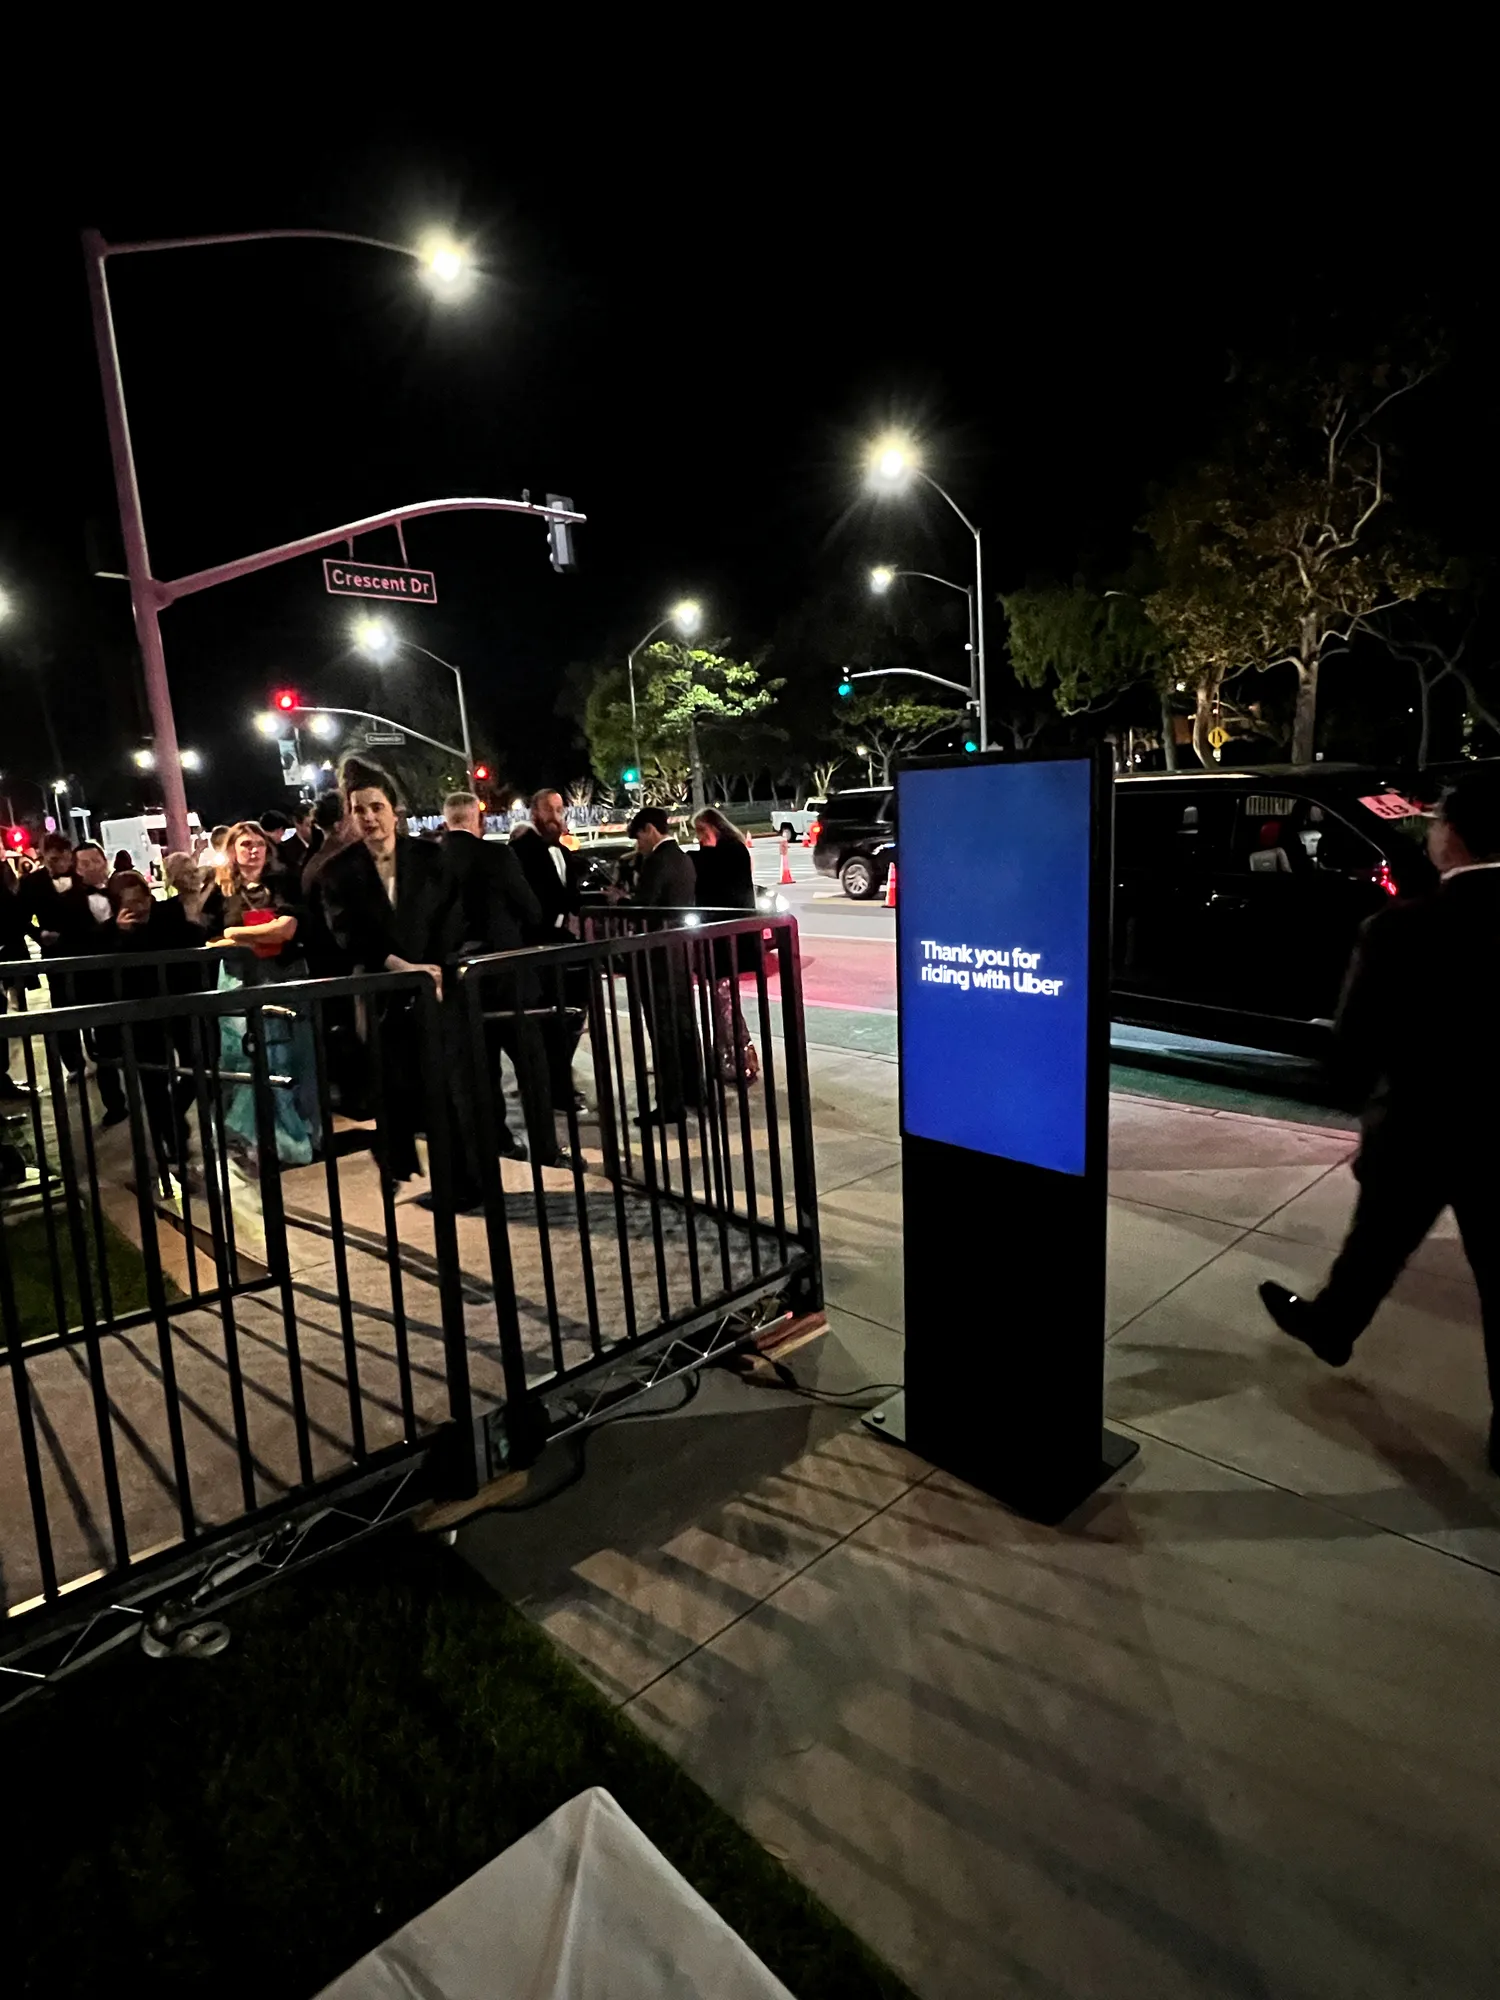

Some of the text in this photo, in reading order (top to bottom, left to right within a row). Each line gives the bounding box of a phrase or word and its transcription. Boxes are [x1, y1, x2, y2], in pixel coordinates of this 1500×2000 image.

[332, 569, 429, 594] Crescent Dr
[920, 940, 1041, 970] Thank you for
[921, 963, 1063, 996] riding with Uber
